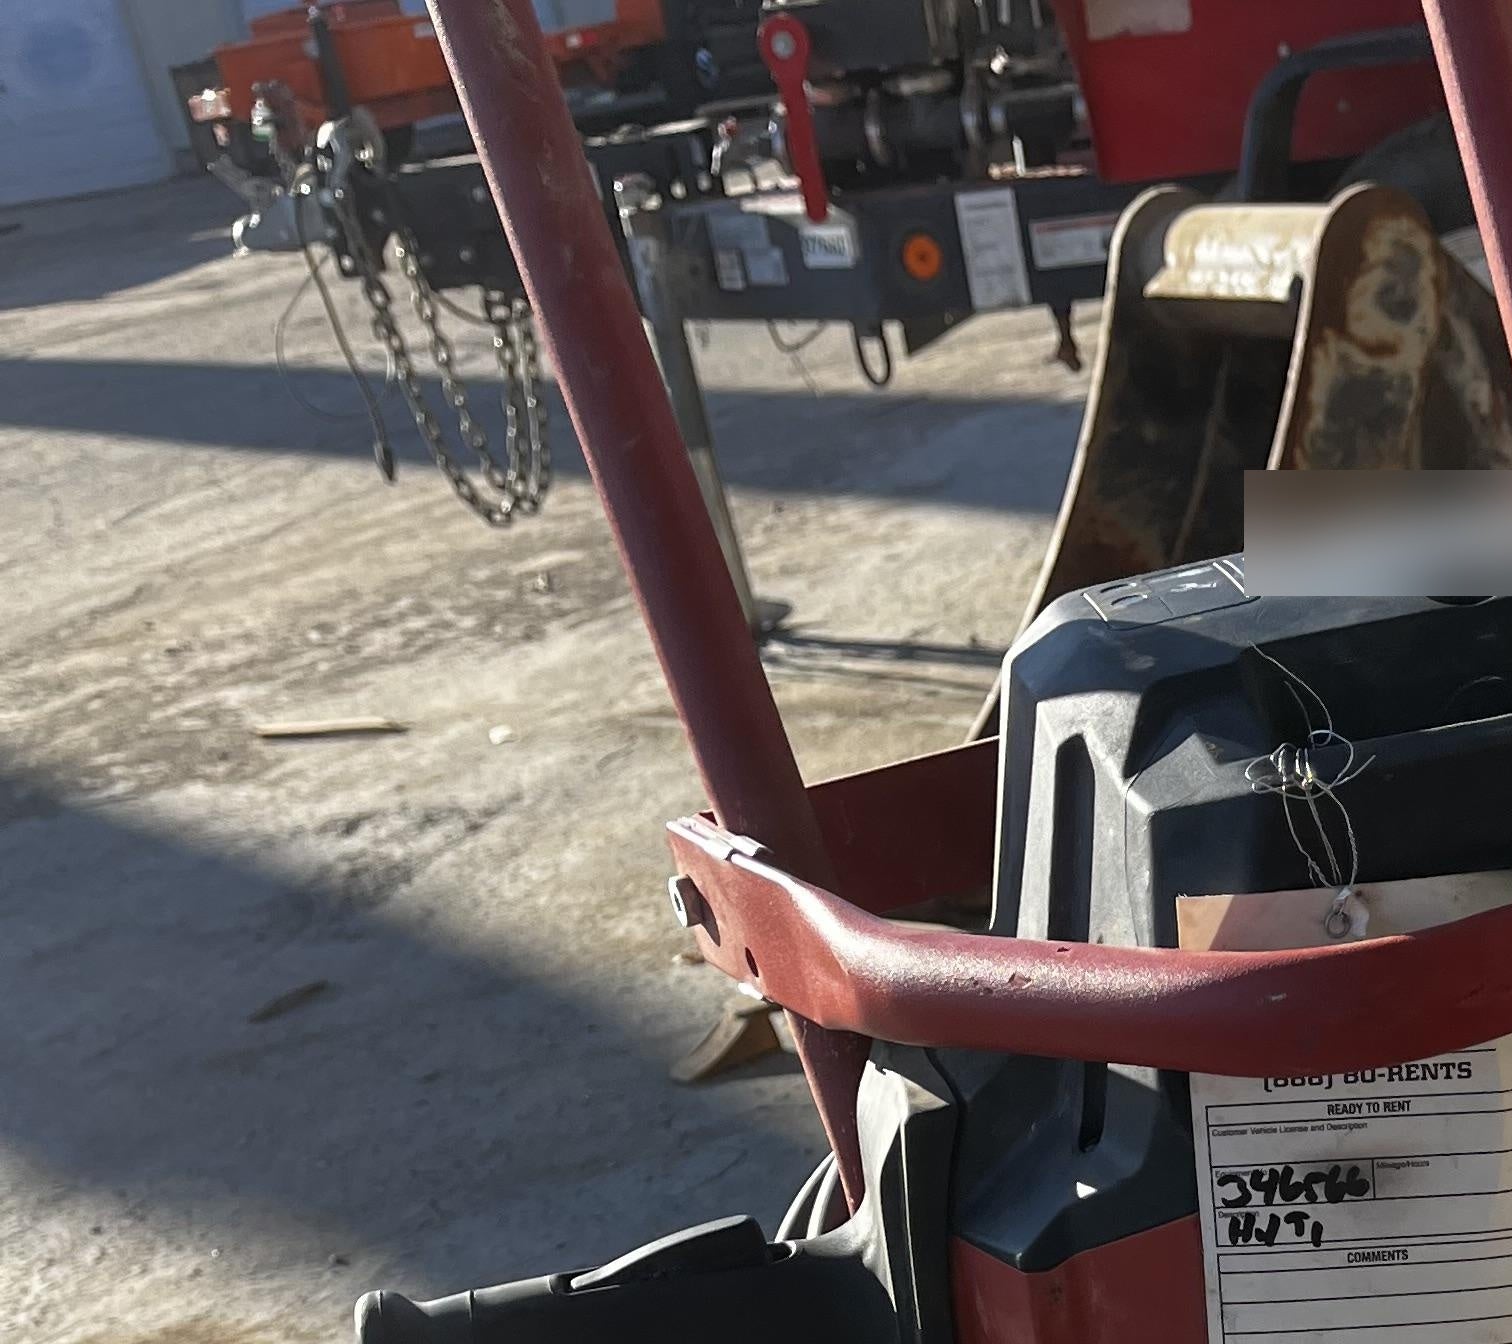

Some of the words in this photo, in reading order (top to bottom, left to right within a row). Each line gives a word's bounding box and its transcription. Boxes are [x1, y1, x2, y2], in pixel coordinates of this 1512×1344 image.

[1327, 1102, 1362, 1115] READY
[1365, 1102, 1380, 1113] TO
[1383, 1100, 1412, 1113] RENT
[1251, 1126, 1278, 1135] Vehicle
[1279, 1124, 1308, 1134] License
[1310, 1122, 1325, 1132] and
[1327, 1122, 1368, 1133] Description
[1347, 1248, 1409, 1263] COMMENTS
